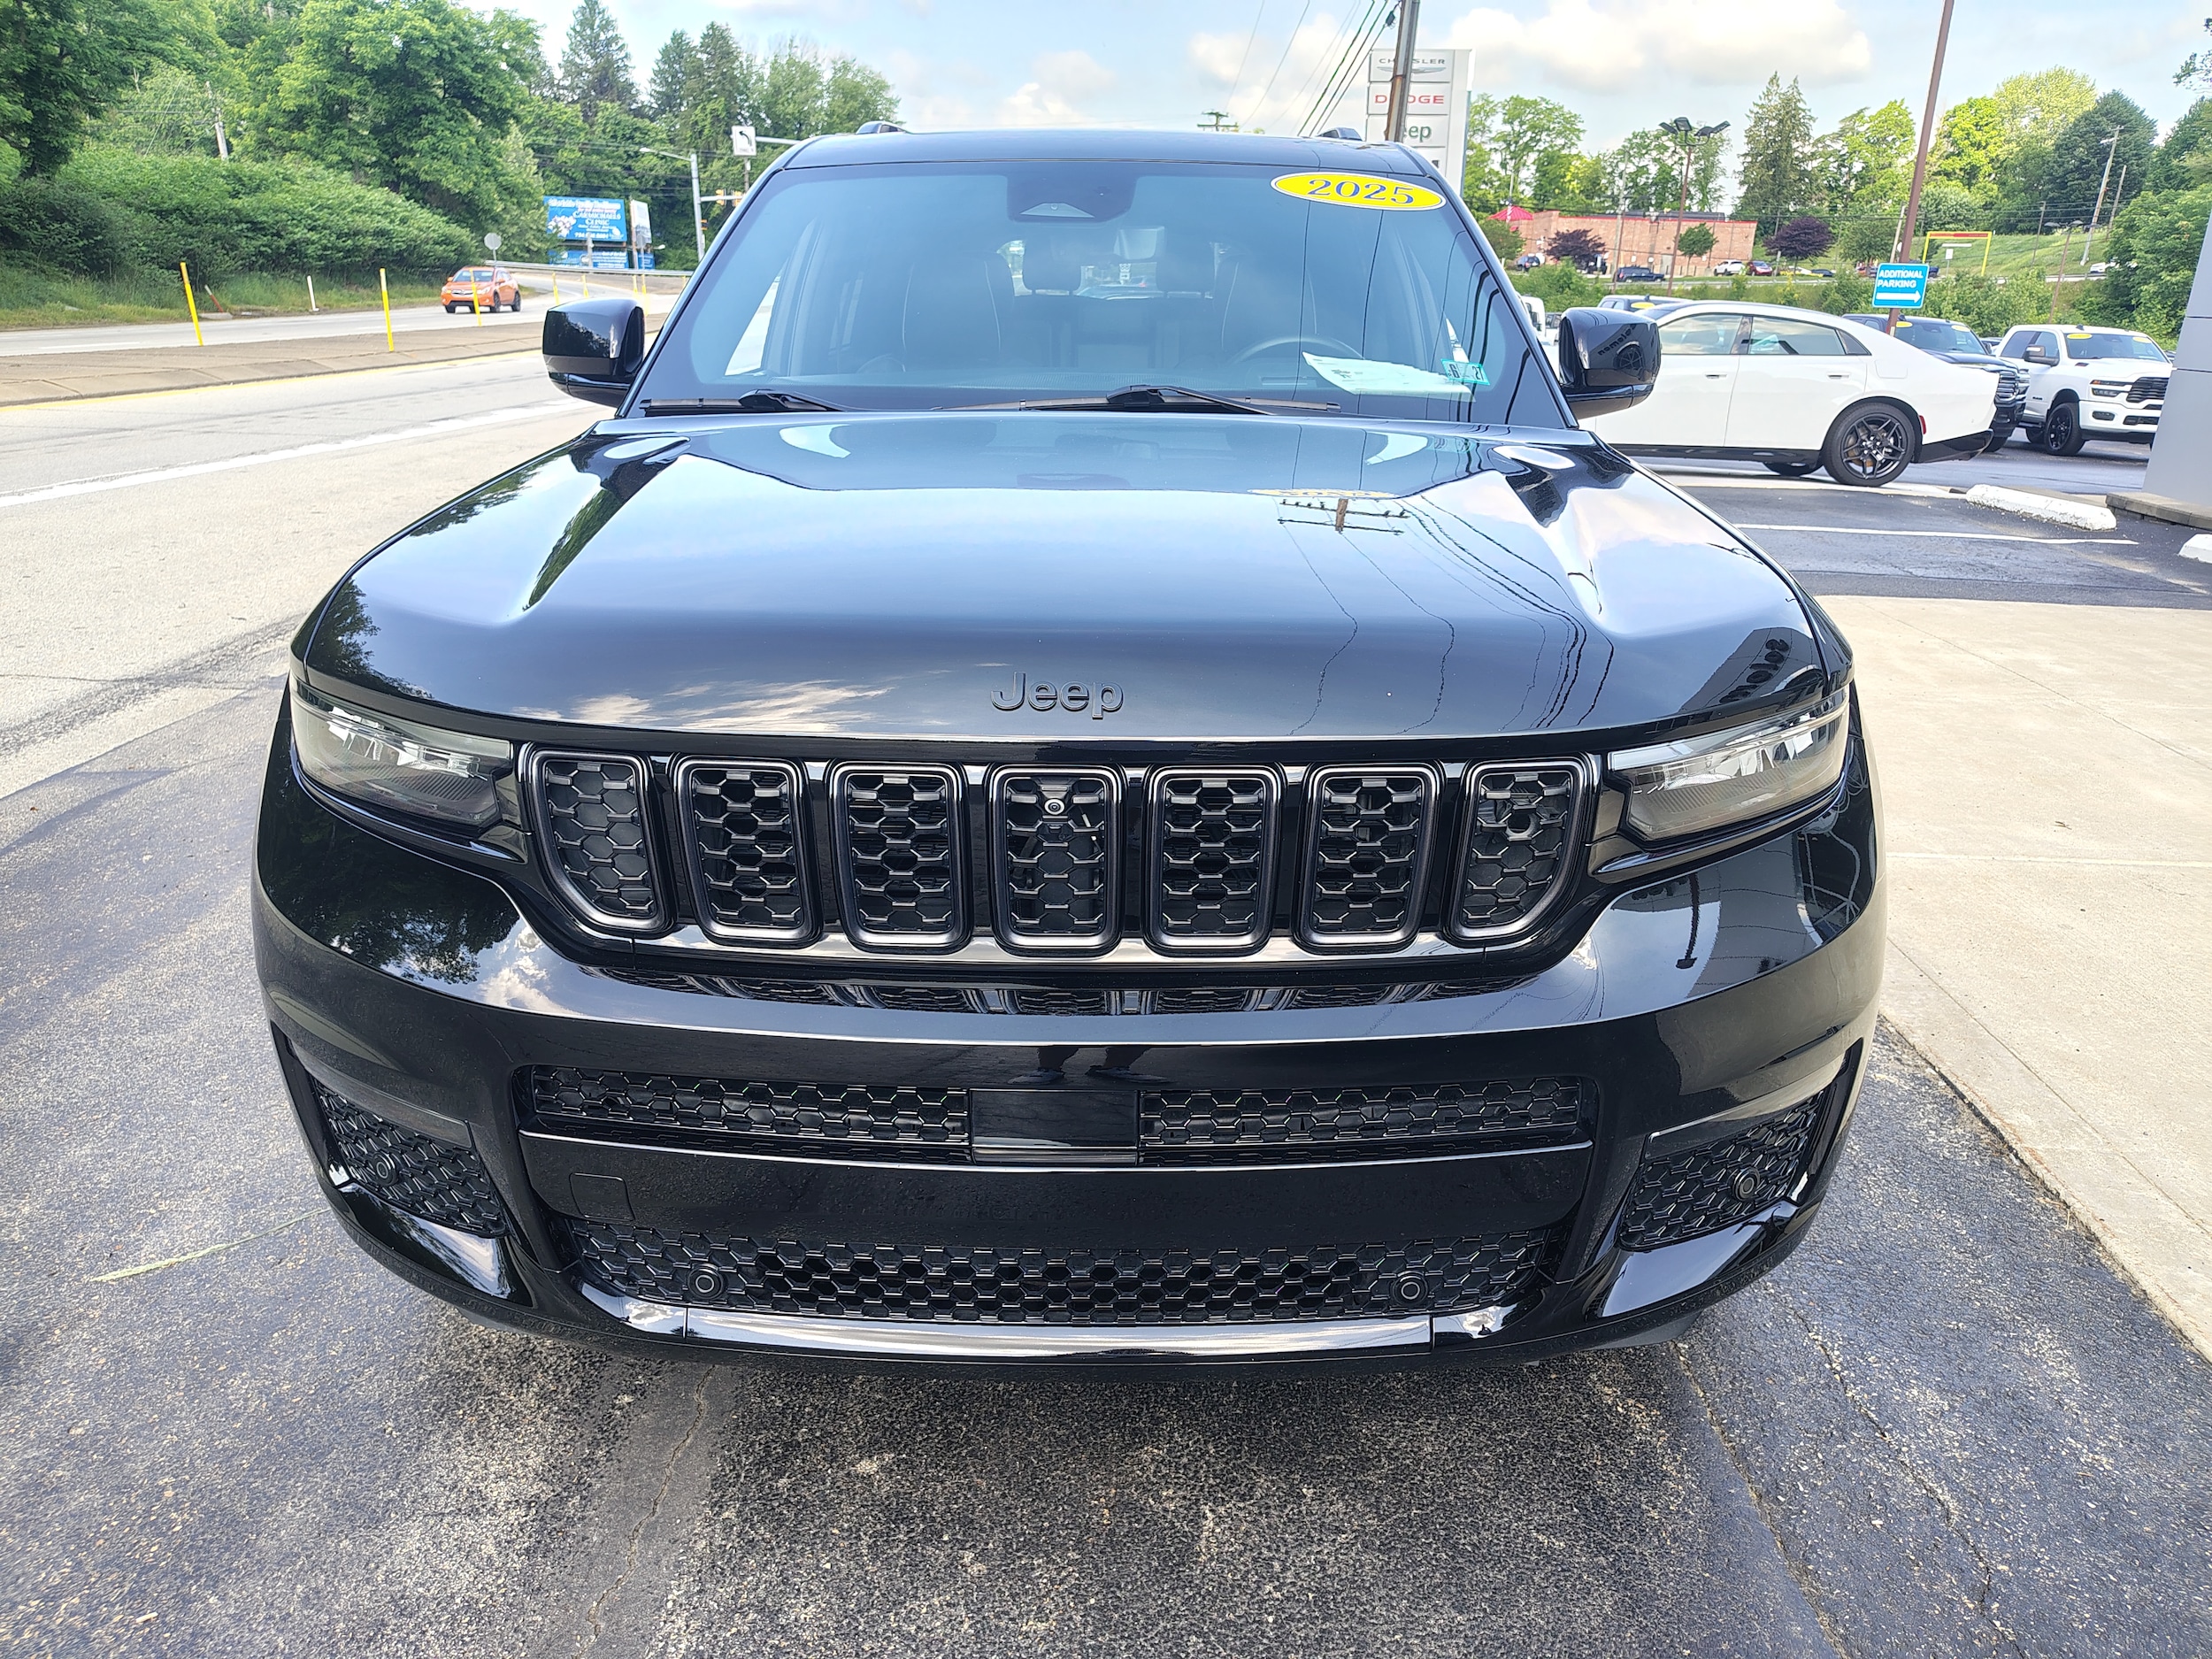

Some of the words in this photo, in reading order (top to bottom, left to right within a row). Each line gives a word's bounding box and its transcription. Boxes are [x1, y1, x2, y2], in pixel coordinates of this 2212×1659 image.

[1374, 95, 1445, 104] DDGE
[1307, 179, 1414, 204] 2025
[1878, 269, 1924, 279] ADDITIONAL
[1877, 279, 1917, 288] PARKING
[990, 671, 1124, 720] Jeep
